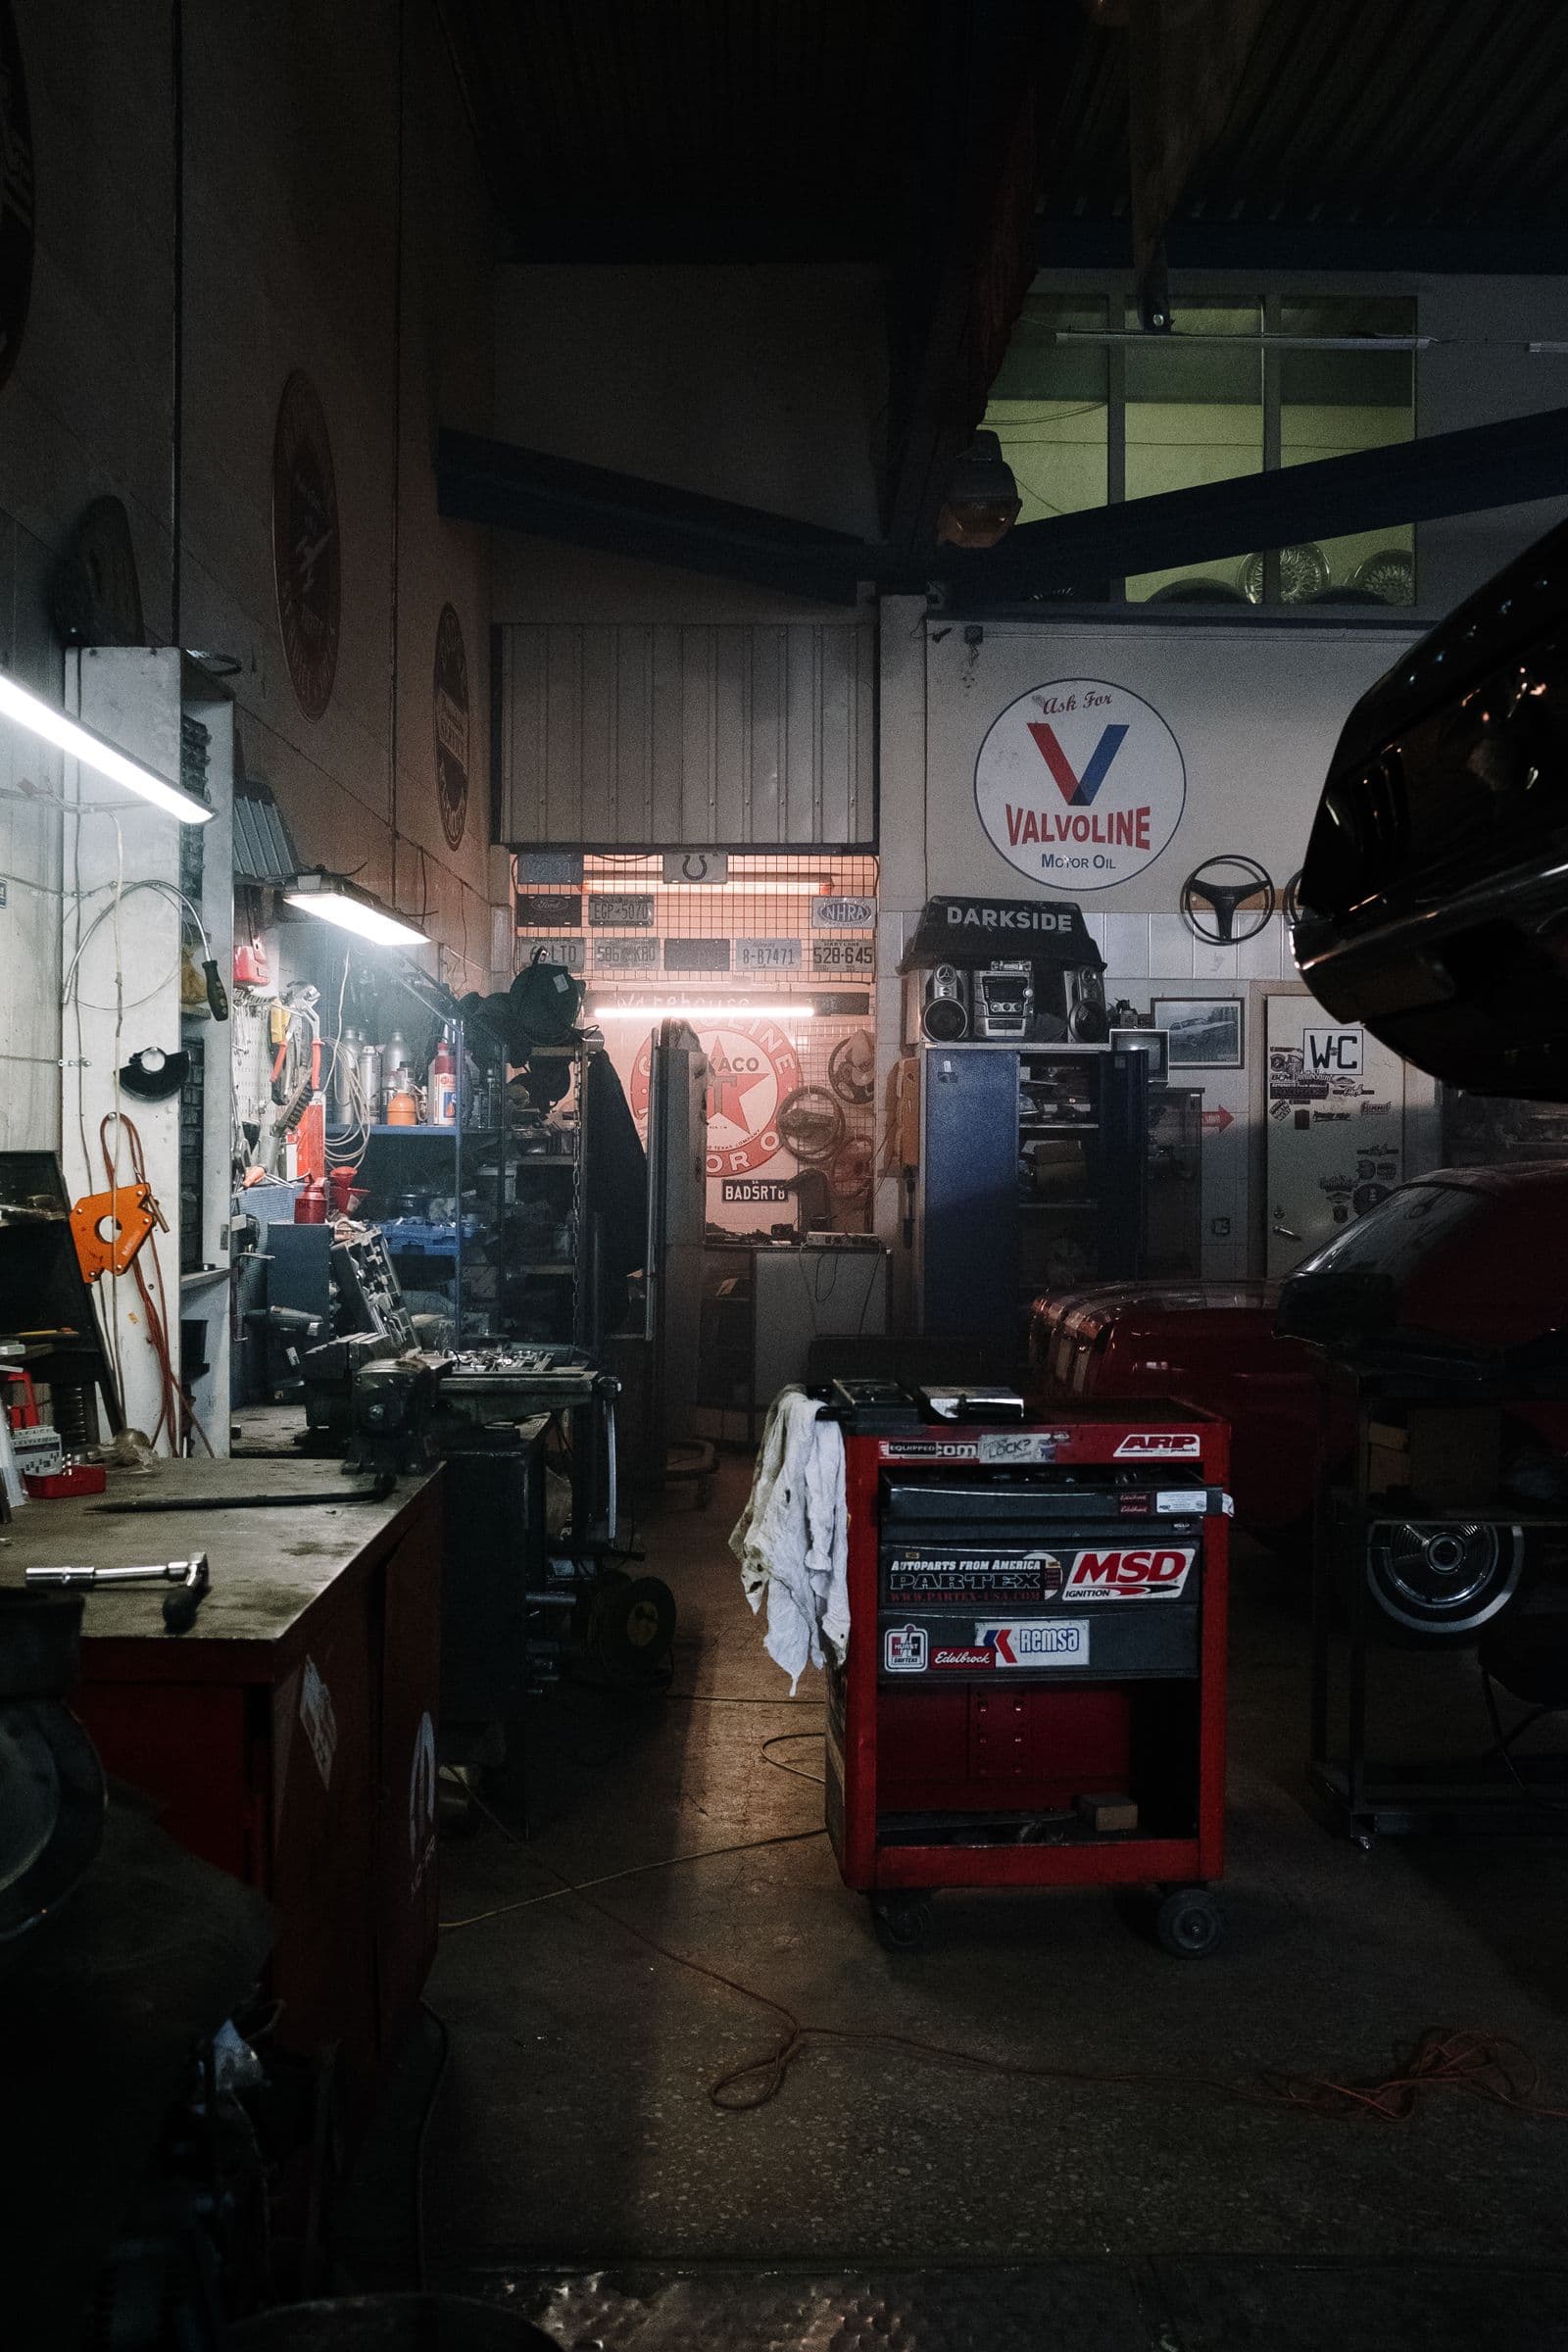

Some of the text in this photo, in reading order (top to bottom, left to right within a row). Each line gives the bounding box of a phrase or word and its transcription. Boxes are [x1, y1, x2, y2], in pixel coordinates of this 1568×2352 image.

[1042, 696, 1077, 715] Ask
[1005, 804, 1151, 851] VALVOLINE
[825, 904, 865, 922] NHRA
[947, 906, 1073, 932] DARKSIDE
[1121, 1436, 1198, 1449] ARP
[891, 1558, 1041, 1572] AUTOPARTS FROM AMERICA
[1072, 1551, 1187, 1584] MSD
[890, 1573, 1041, 1591] PARTEX
[1065, 1590, 1110, 1598] IGNITION
[934, 1650, 991, 1665] Edelbrock
